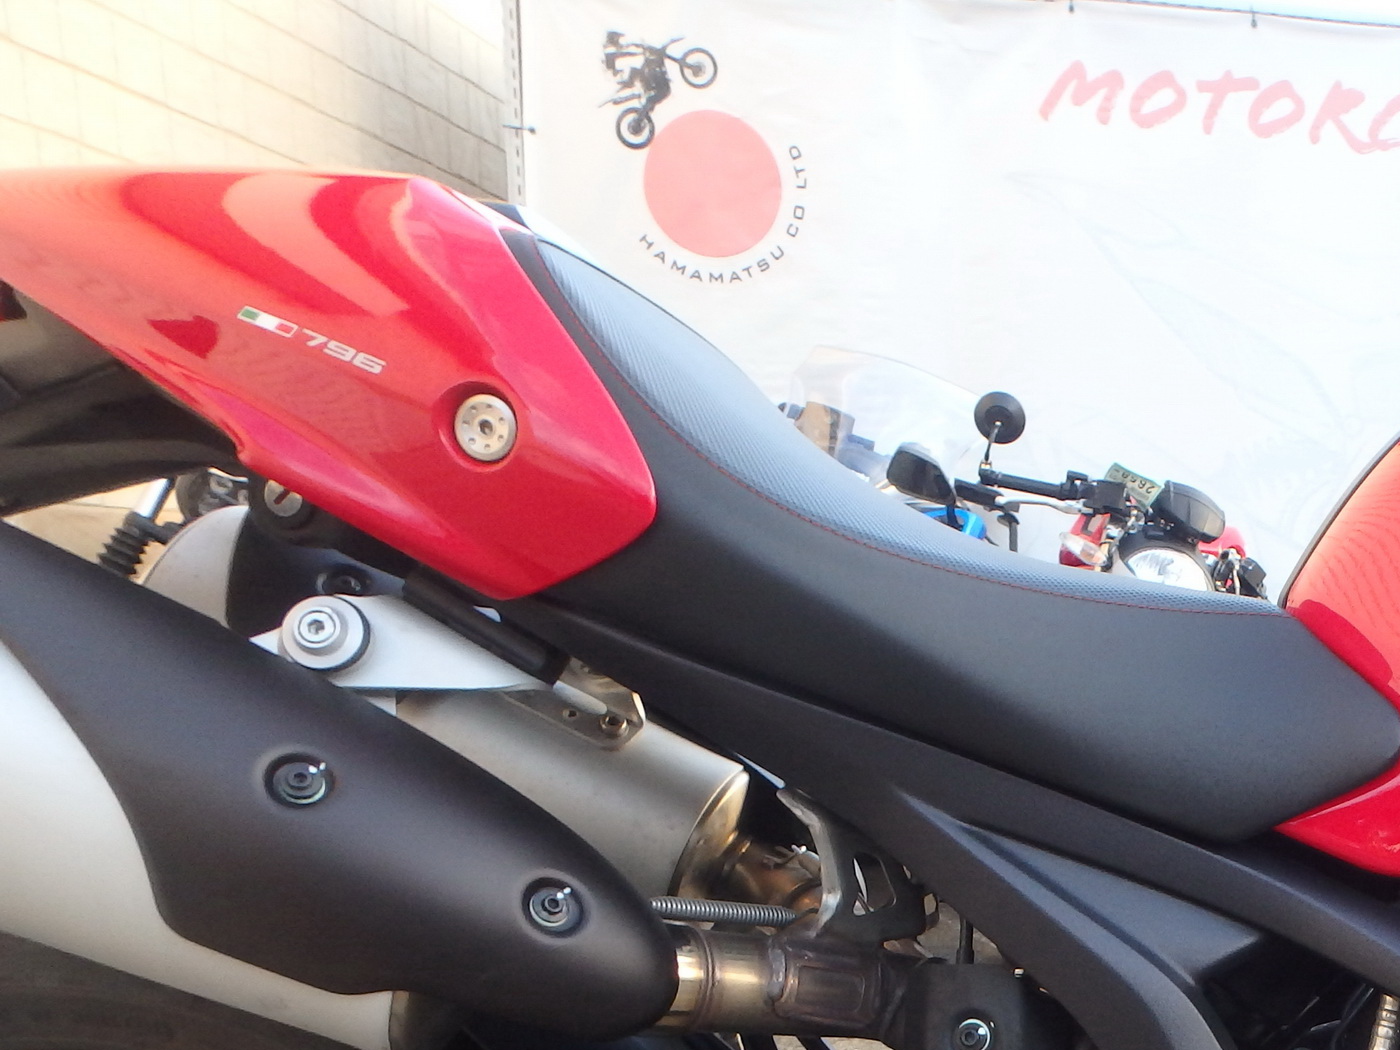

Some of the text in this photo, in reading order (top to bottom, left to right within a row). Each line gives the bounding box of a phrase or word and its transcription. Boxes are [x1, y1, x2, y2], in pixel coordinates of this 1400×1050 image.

[639, 144, 808, 284] HAMAMATSU CO LTD
[301, 328, 388, 375] 796
